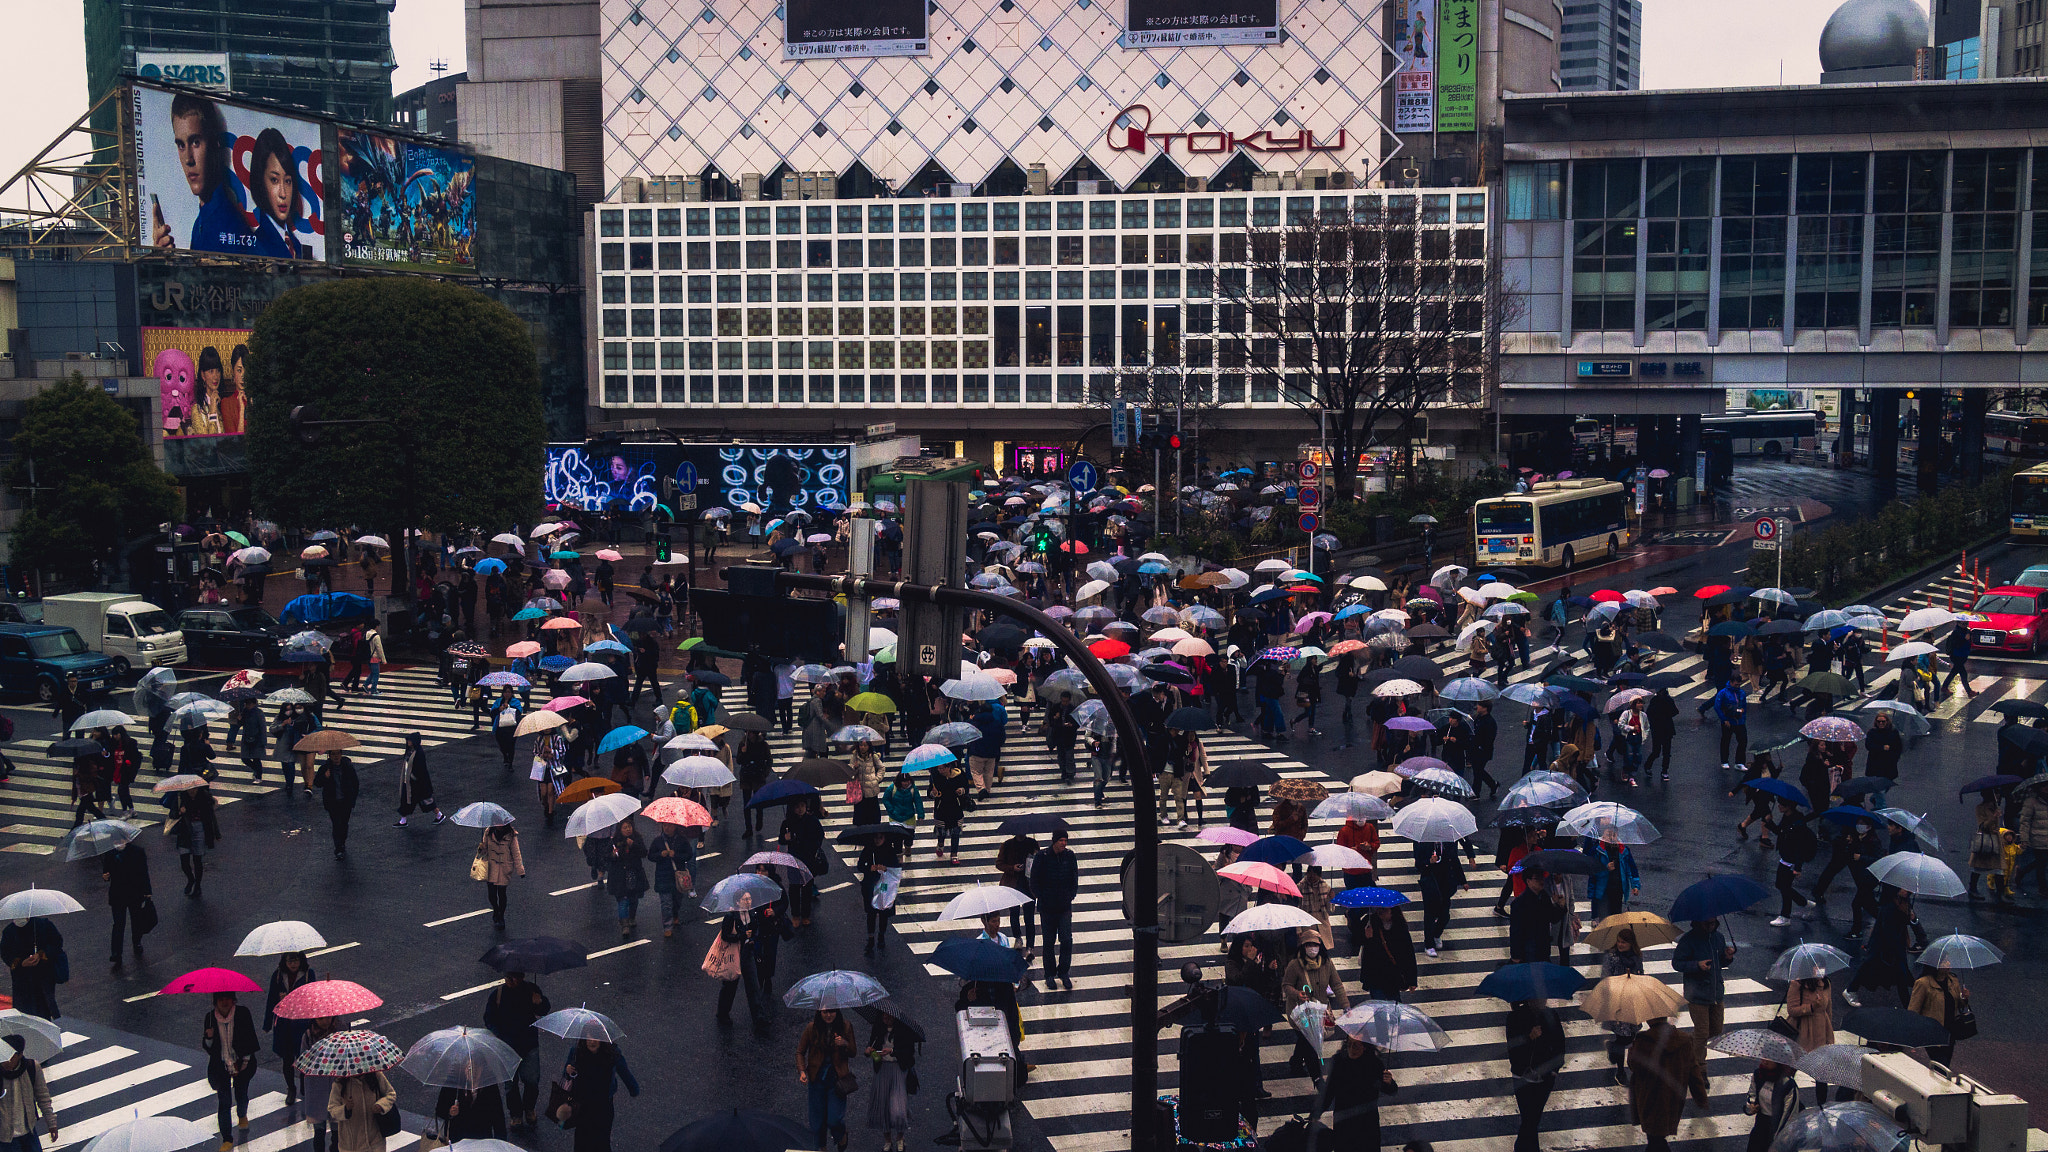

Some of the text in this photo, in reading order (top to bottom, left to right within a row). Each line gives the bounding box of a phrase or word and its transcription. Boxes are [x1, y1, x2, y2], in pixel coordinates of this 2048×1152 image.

[803, 26, 911, 38] ※この方は実際の会員です。
[1453, 0, 1474, 75] まつり
[1147, 129, 1346, 154] TOKYU
[133, 89, 148, 241] SUPER STUDENT SoftBank
[151, 280, 186, 311] JR
[190, 284, 243, 312] 渋谷駅
